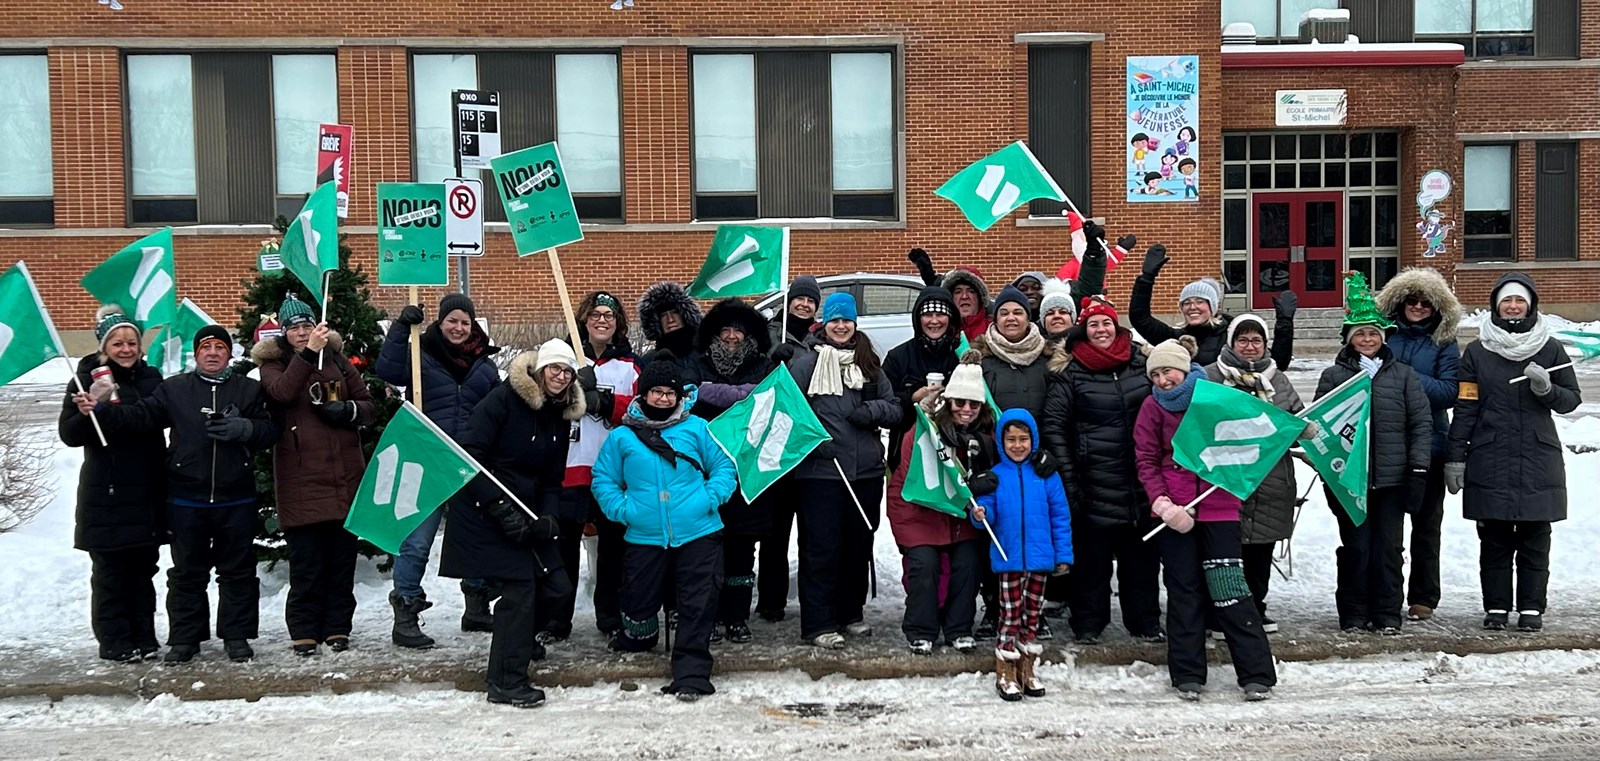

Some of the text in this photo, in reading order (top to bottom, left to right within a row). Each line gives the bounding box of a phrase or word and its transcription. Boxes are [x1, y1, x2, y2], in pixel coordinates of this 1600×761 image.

[1138, 81, 1196, 94] SAINT-MICHEL
[460, 93, 478, 102] exo
[461, 110, 475, 121] 115
[480, 112, 486, 122] 5
[1138, 104, 1186, 121] LITTÉRATURE
[1138, 115, 1188, 132] JEUNESSE
[322, 134, 340, 152] GRÈVE
[462, 135, 472, 145] 15
[500, 160, 560, 200] NOUS
[382, 199, 442, 228] NOUS
